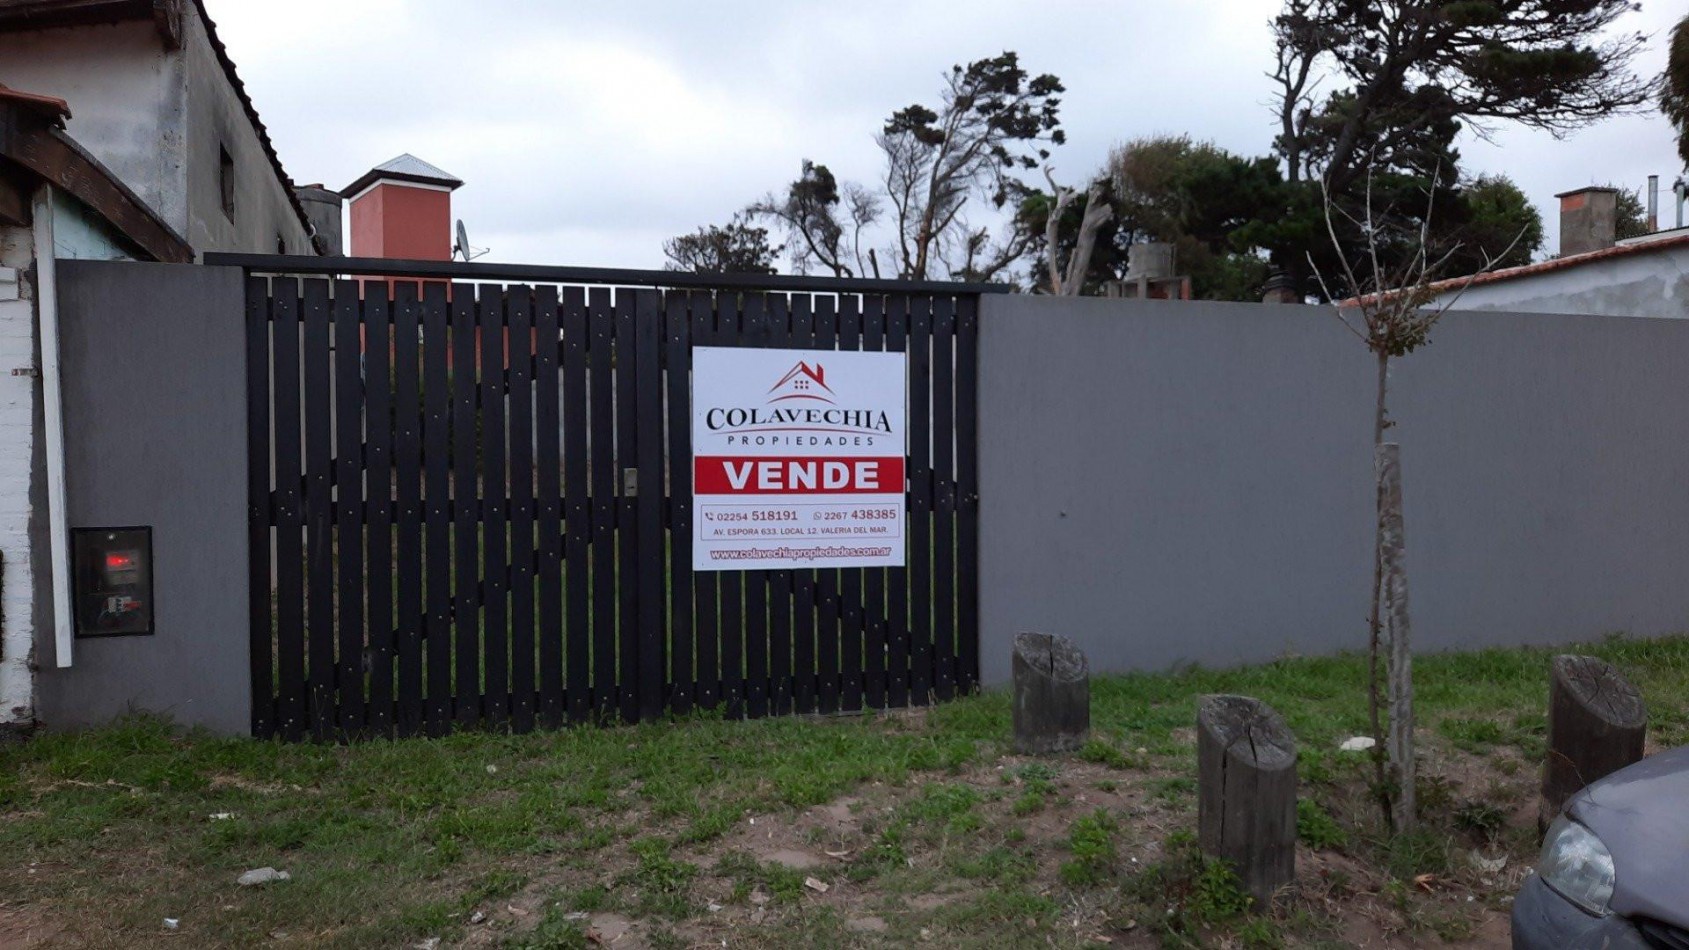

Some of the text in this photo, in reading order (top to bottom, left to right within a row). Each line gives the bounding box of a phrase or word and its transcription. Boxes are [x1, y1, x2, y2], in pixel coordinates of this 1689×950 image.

[706, 408, 892, 433] COLAVECHIA
[728, 436, 873, 446] PROPIEDADES
[722, 461, 879, 490] VENDE
[717, 510, 896, 521] 02254 518191 2267 438385
[710, 546, 891, 560] www.colavechiapropiedades.com.ar
